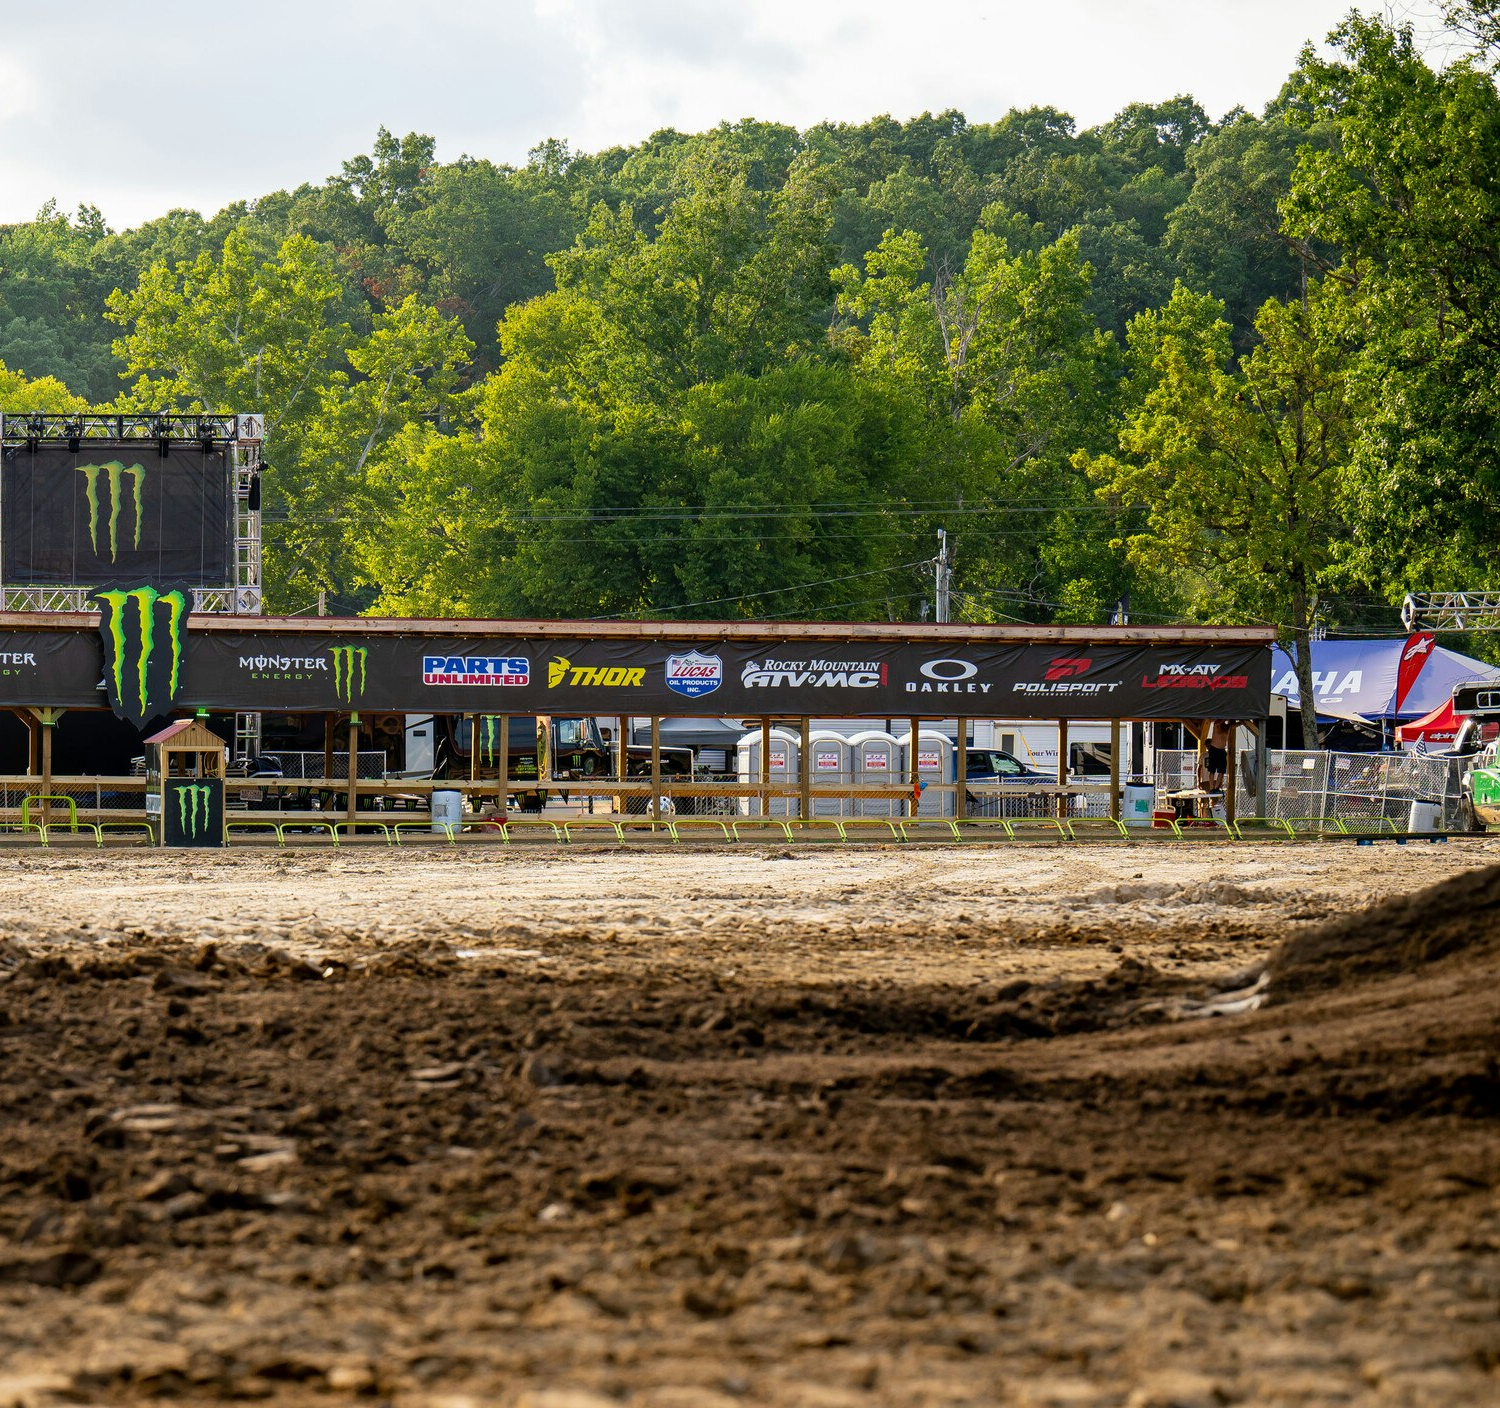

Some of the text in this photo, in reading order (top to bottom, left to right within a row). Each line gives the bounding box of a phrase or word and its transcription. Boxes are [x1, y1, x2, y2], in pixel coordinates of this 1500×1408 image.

[239, 655, 328, 671] MONSTER
[424, 657, 529, 675] PARTS
[765, 659, 881, 672] ROCKY MOUNTAIN
[569, 667, 647, 687] THOR
[672, 666, 718, 678] LUCAS
[424, 673, 529, 686] UNLIMITED
[1141, 675, 1248, 691] LEGENDS
[905, 682, 993, 693] OAKLEY
[1012, 683, 1119, 692] POLISPORT
